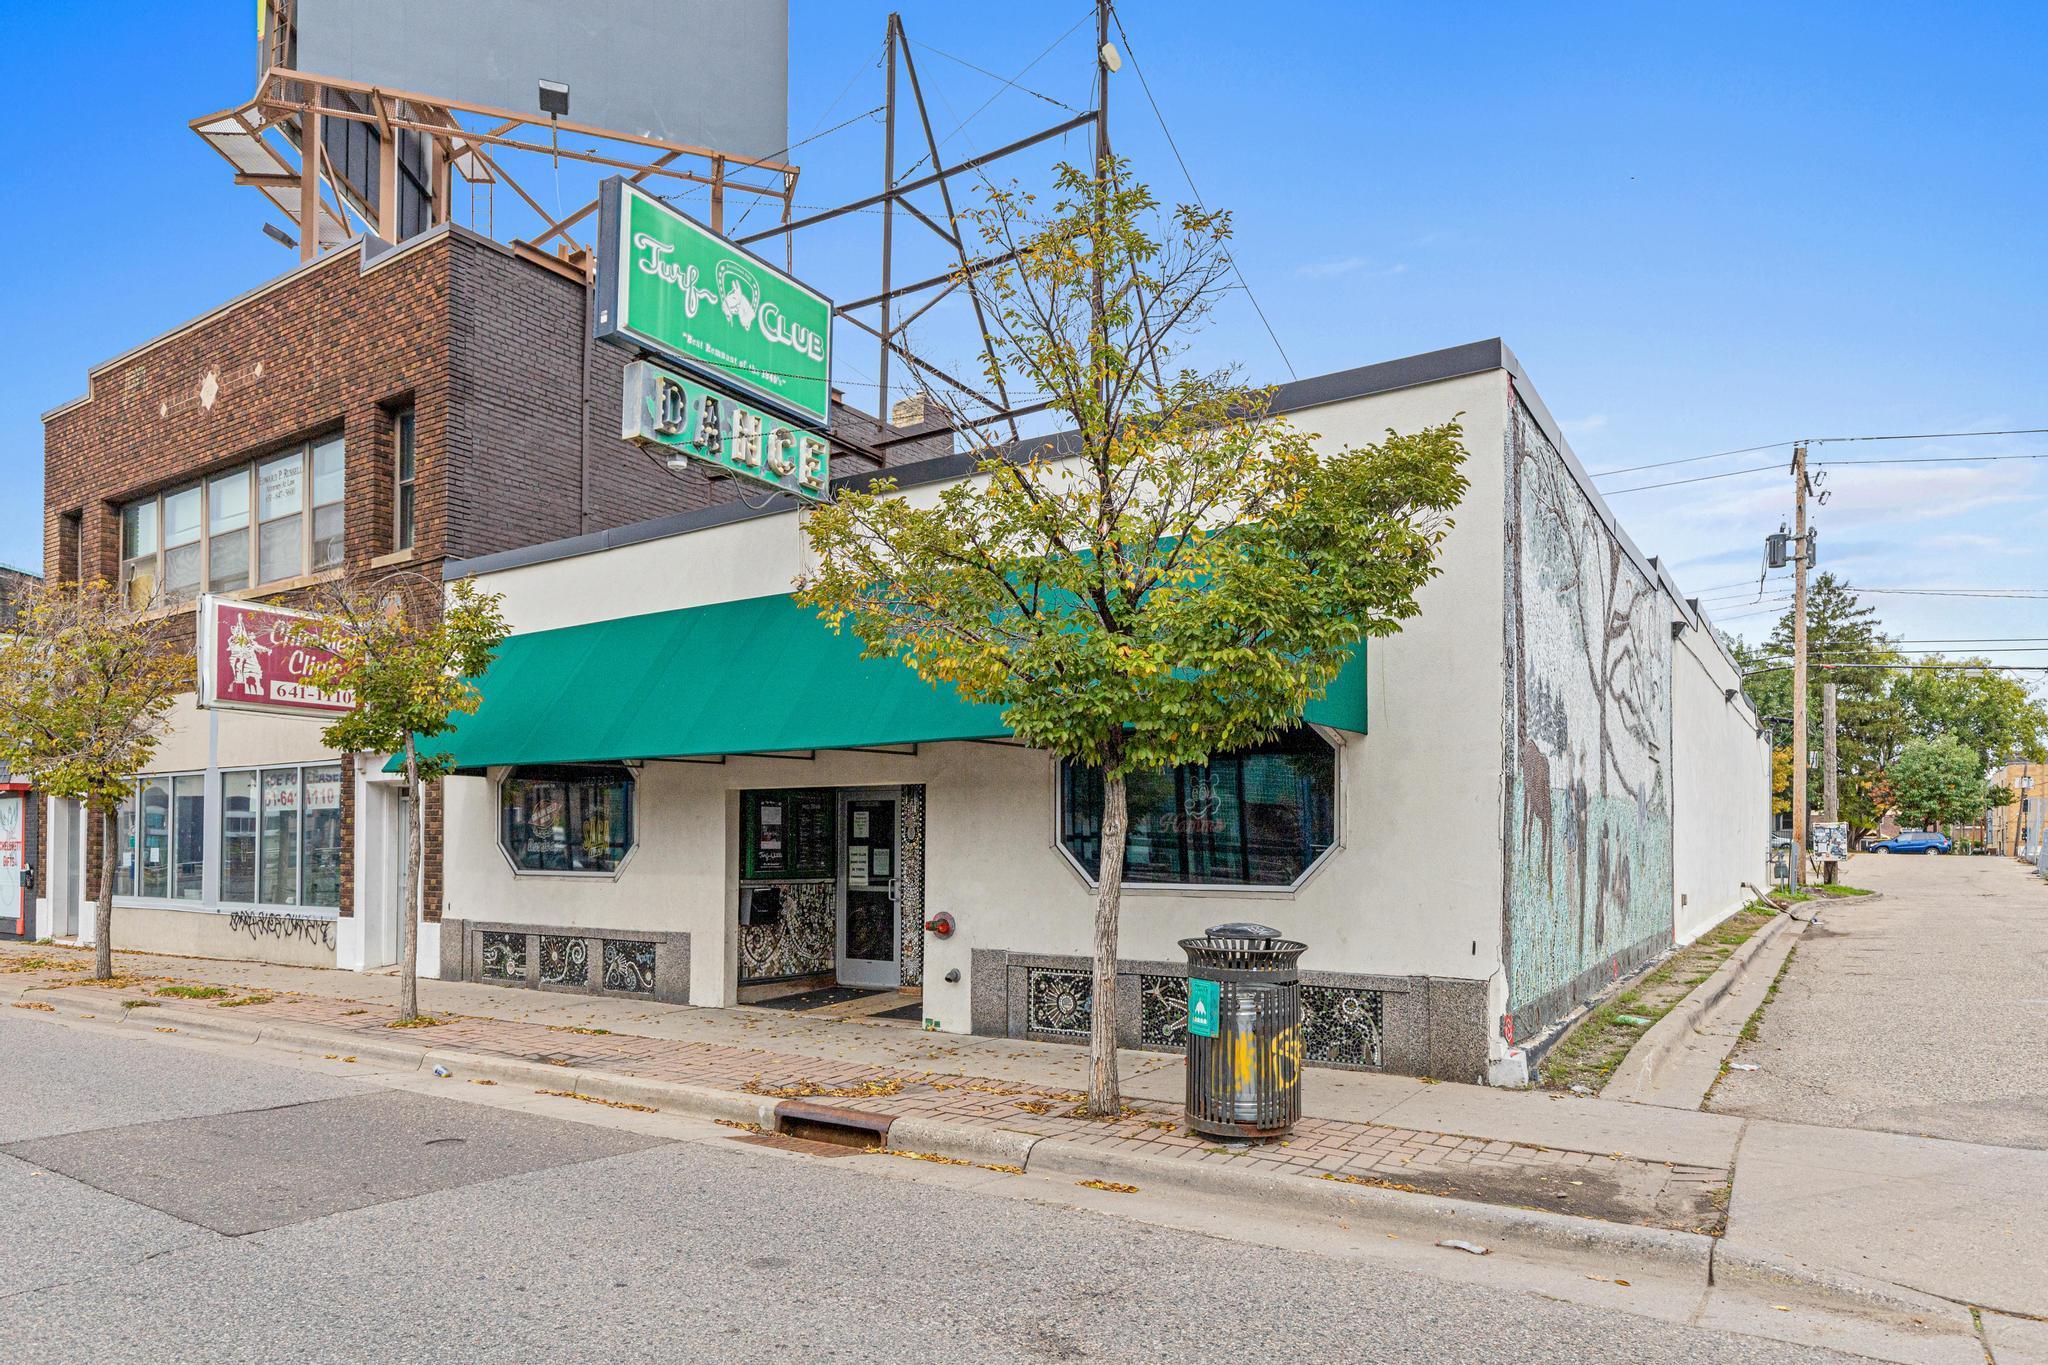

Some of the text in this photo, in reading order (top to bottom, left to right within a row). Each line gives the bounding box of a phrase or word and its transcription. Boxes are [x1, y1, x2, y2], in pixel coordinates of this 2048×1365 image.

[634, 232, 825, 362] Turf CLUB
[705, 342, 738, 365] Remnant
[739, 360, 747, 369] of
[655, 376, 826, 492] DANCE
